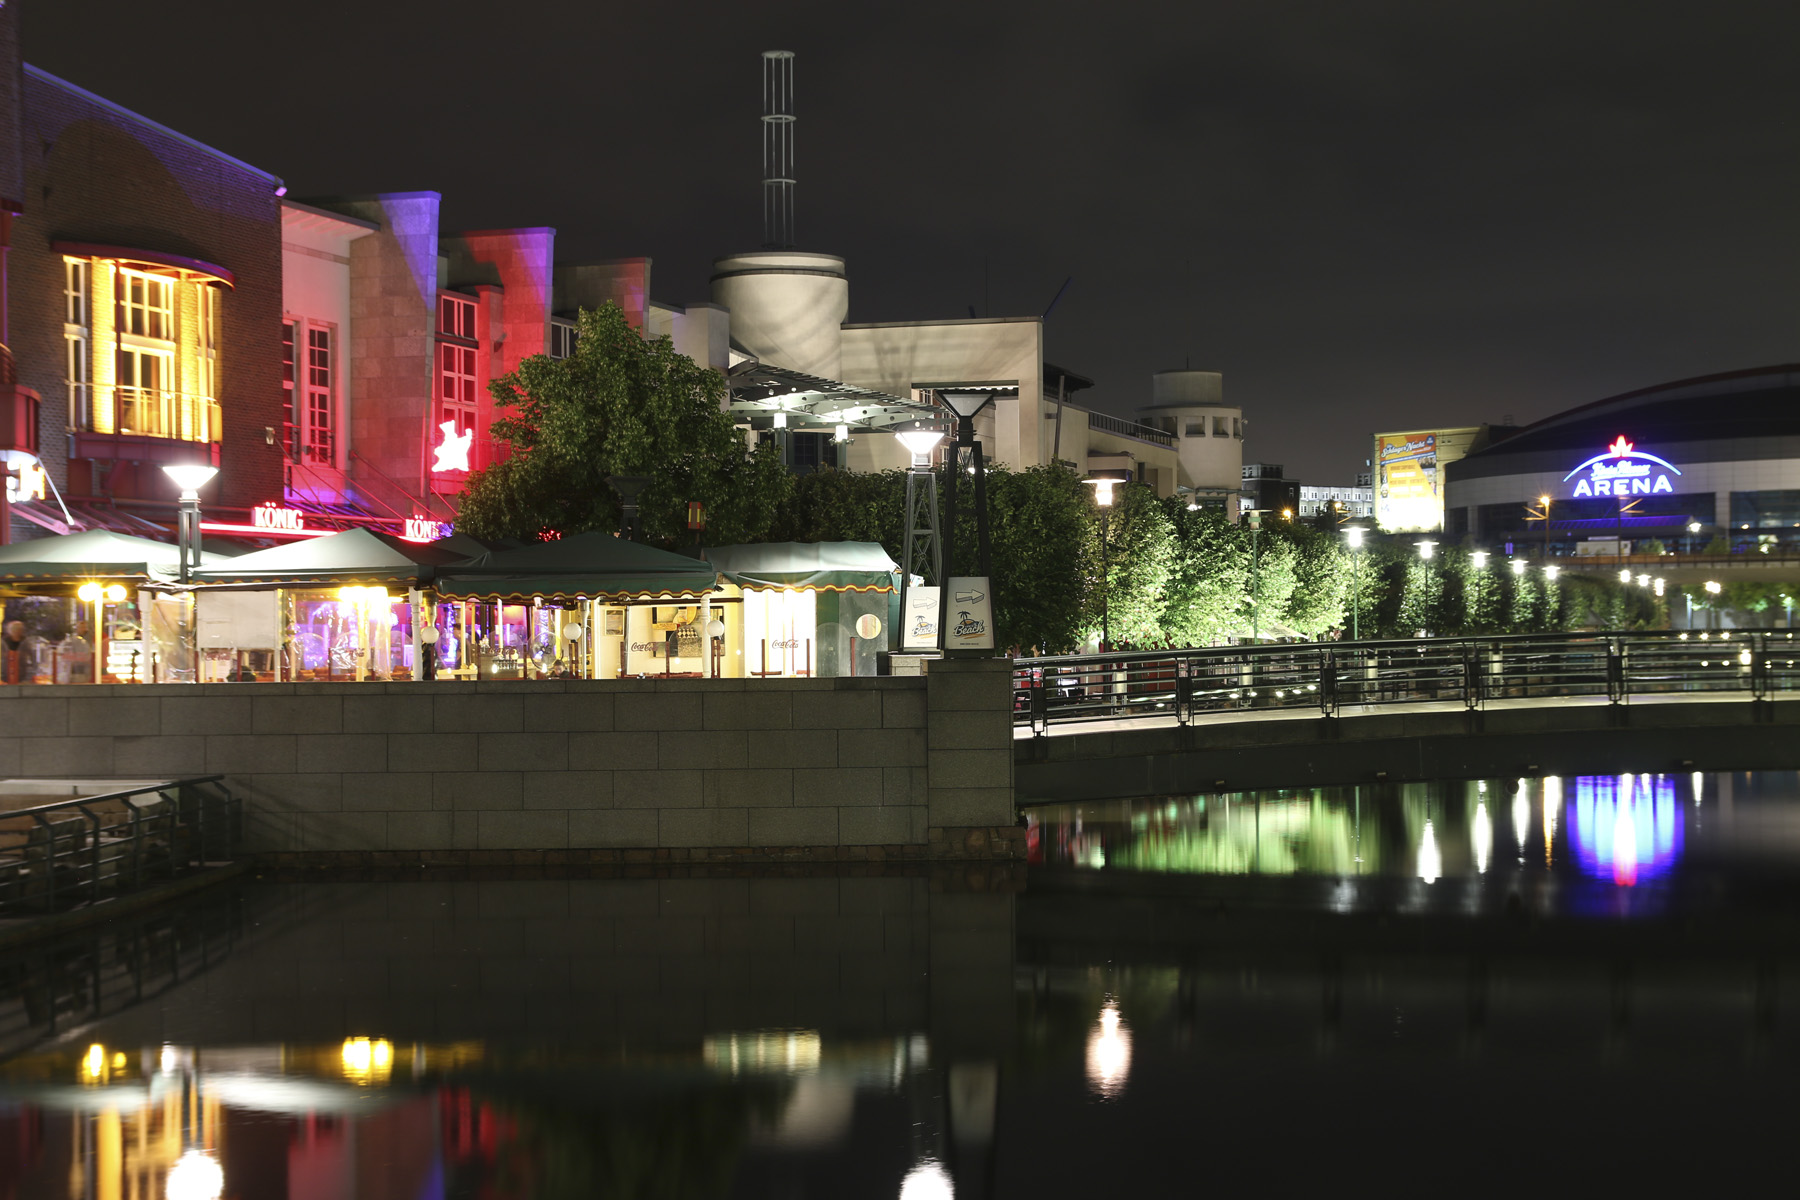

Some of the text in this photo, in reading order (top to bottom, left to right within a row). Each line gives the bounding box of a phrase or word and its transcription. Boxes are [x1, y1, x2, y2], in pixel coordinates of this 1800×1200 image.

[1573, 474, 1673, 497] ARENA
[254, 502, 304, 530] KÖNIG
[953, 620, 985, 637] Beach
